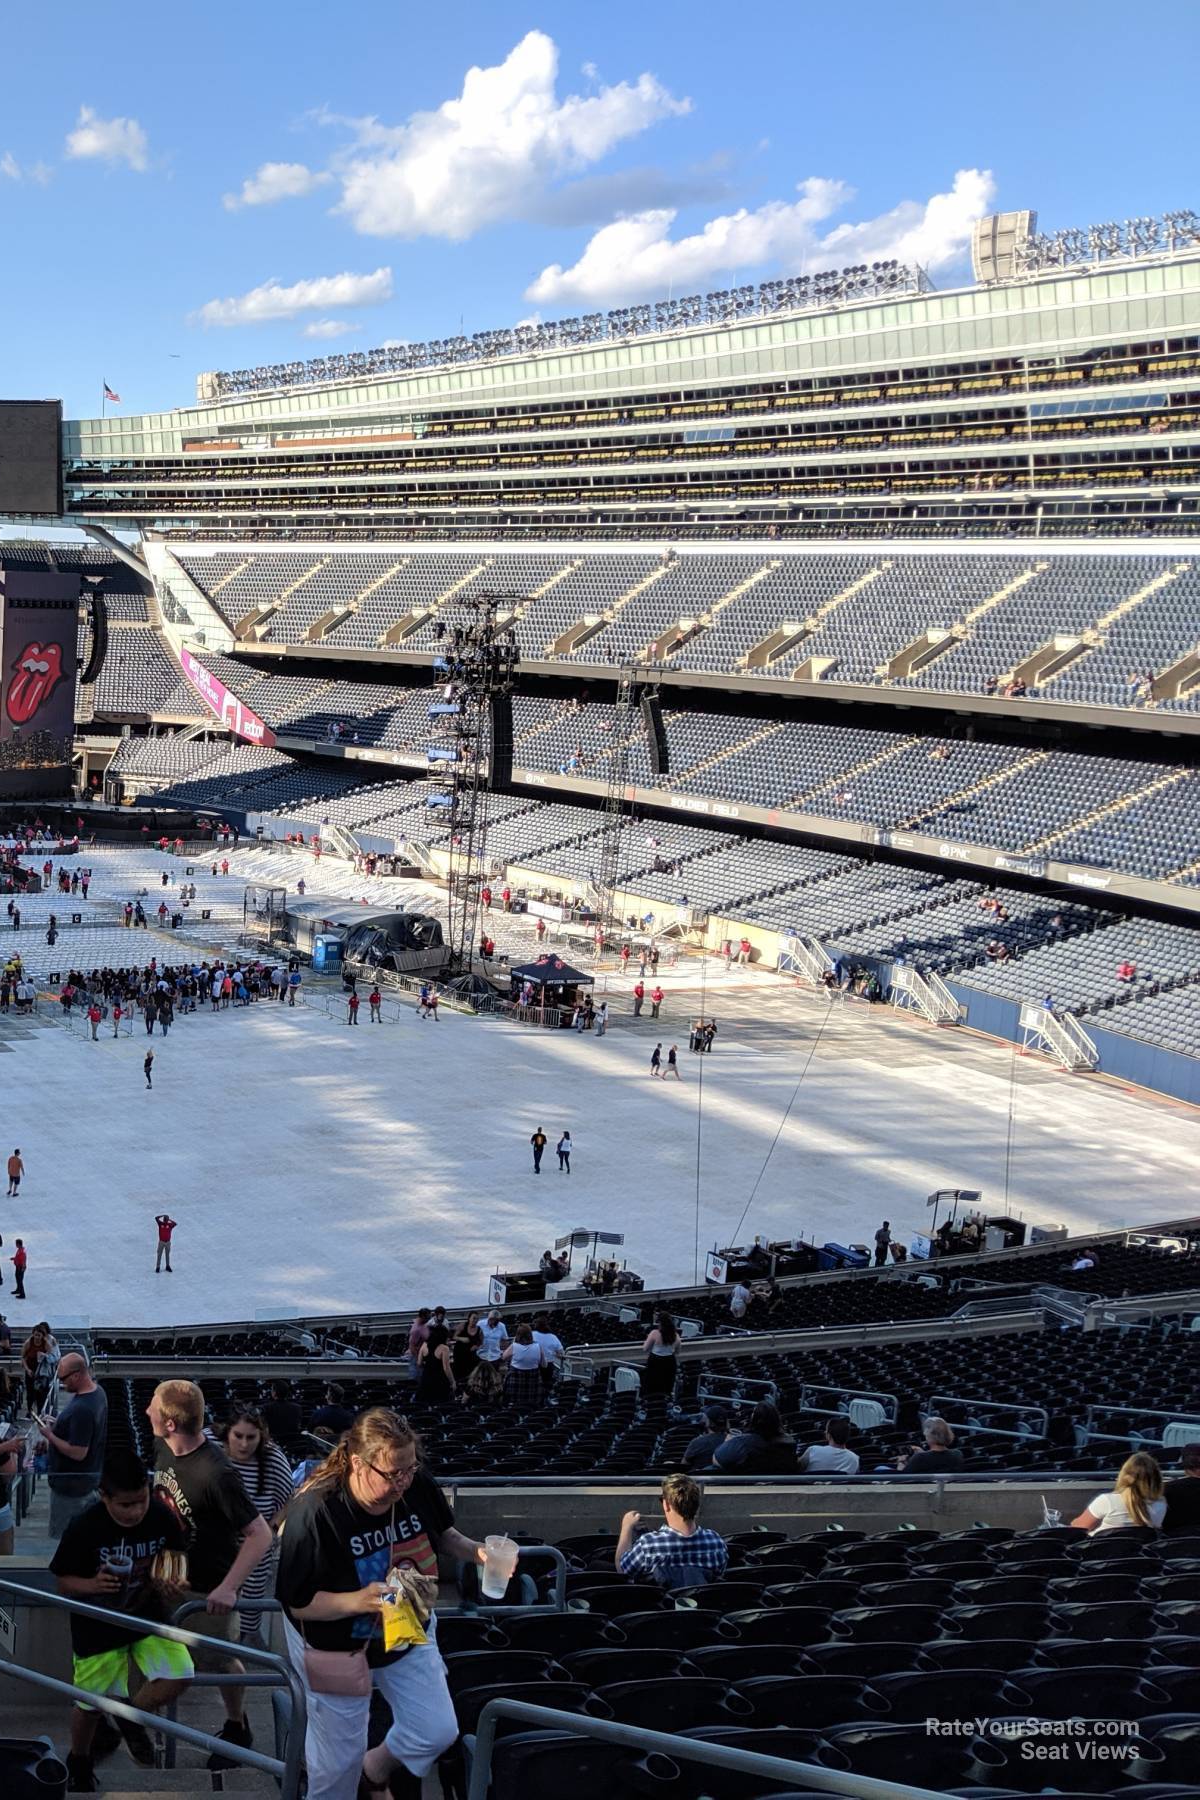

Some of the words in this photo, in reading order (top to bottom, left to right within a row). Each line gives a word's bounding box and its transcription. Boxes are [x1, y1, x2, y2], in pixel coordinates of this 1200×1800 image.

[671, 797, 709, 812] SOLDIER
[712, 803, 738, 817] FIELD
[950, 846, 971, 860] PNC
[350, 1514, 422, 1556] STONES
[99, 1536, 166, 1561] STONES
